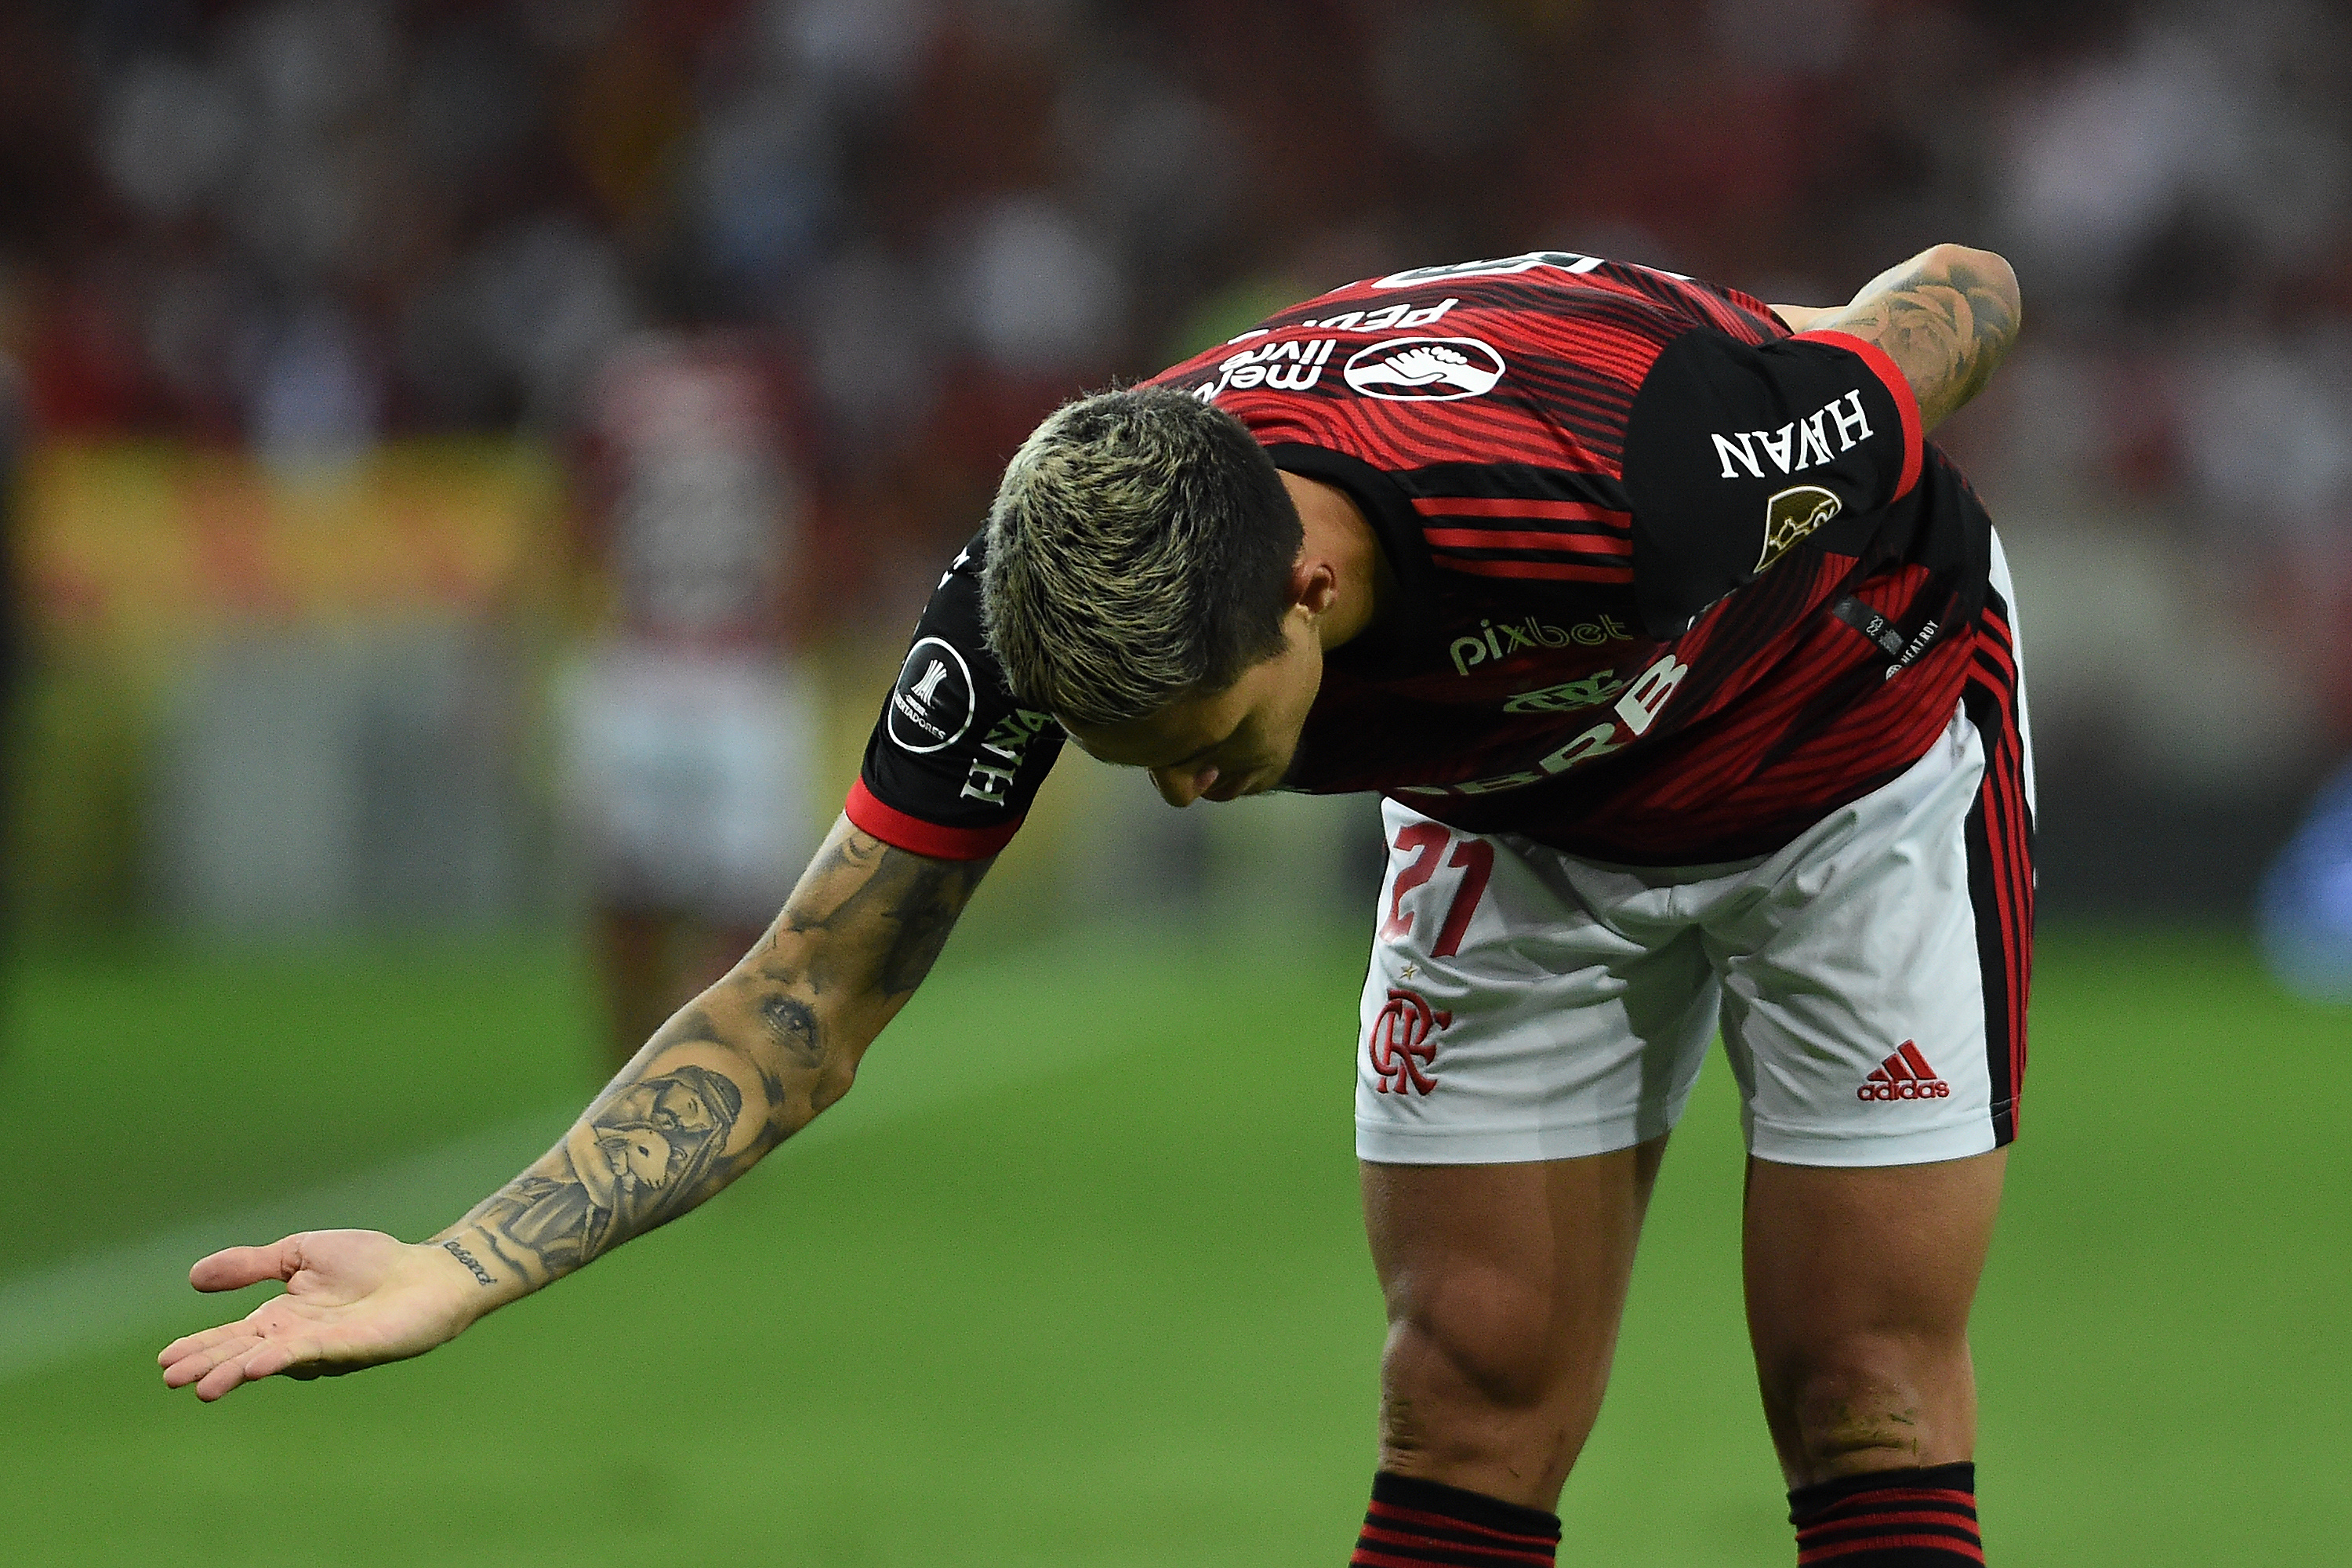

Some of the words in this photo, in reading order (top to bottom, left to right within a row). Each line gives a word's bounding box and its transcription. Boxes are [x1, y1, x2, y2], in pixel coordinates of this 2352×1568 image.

[1227, 298, 1460, 345] PED
[1450, 614, 1634, 676] pixbet
[1378, 821, 1495, 958] 21
[1857, 1080, 1950, 1101] adidas
